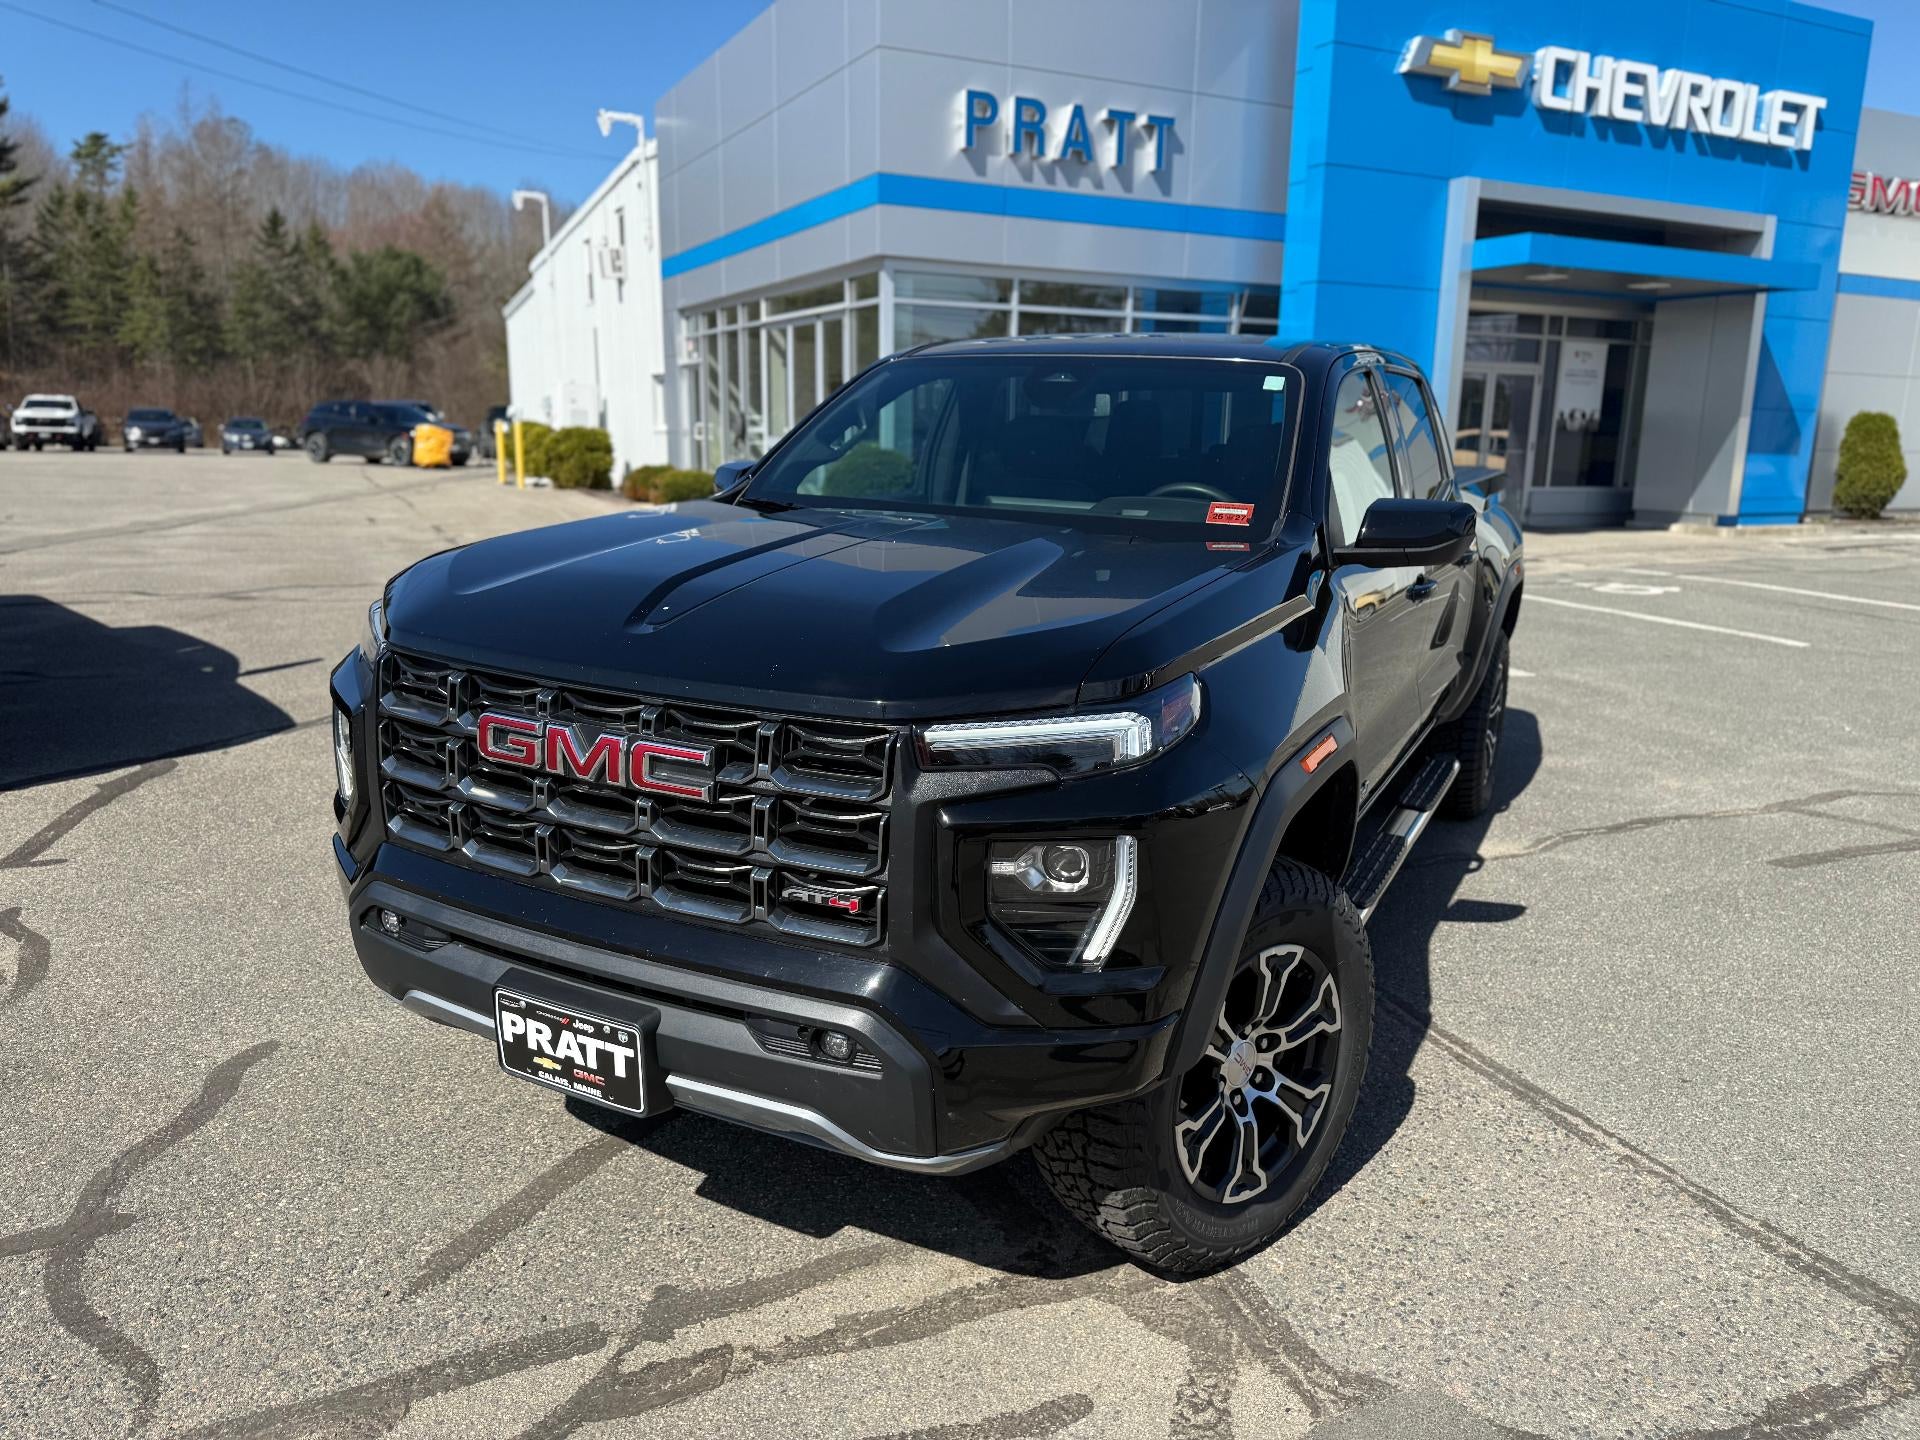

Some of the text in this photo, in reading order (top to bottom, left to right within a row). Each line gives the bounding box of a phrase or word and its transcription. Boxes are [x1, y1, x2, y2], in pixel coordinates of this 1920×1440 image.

[1535, 46, 1827, 151] CHEVROLET
[962, 87, 1176, 173] PRATT
[1848, 171, 1920, 215] GM
[476, 711, 715, 803] GMC
[781, 886, 861, 914] AT4
[501, 1010, 635, 1079] PRATT
[572, 1018, 595, 1034] Jeep
[538, 1069, 602, 1098] CALAIS, MAINE
[573, 1067, 605, 1086] GMC
